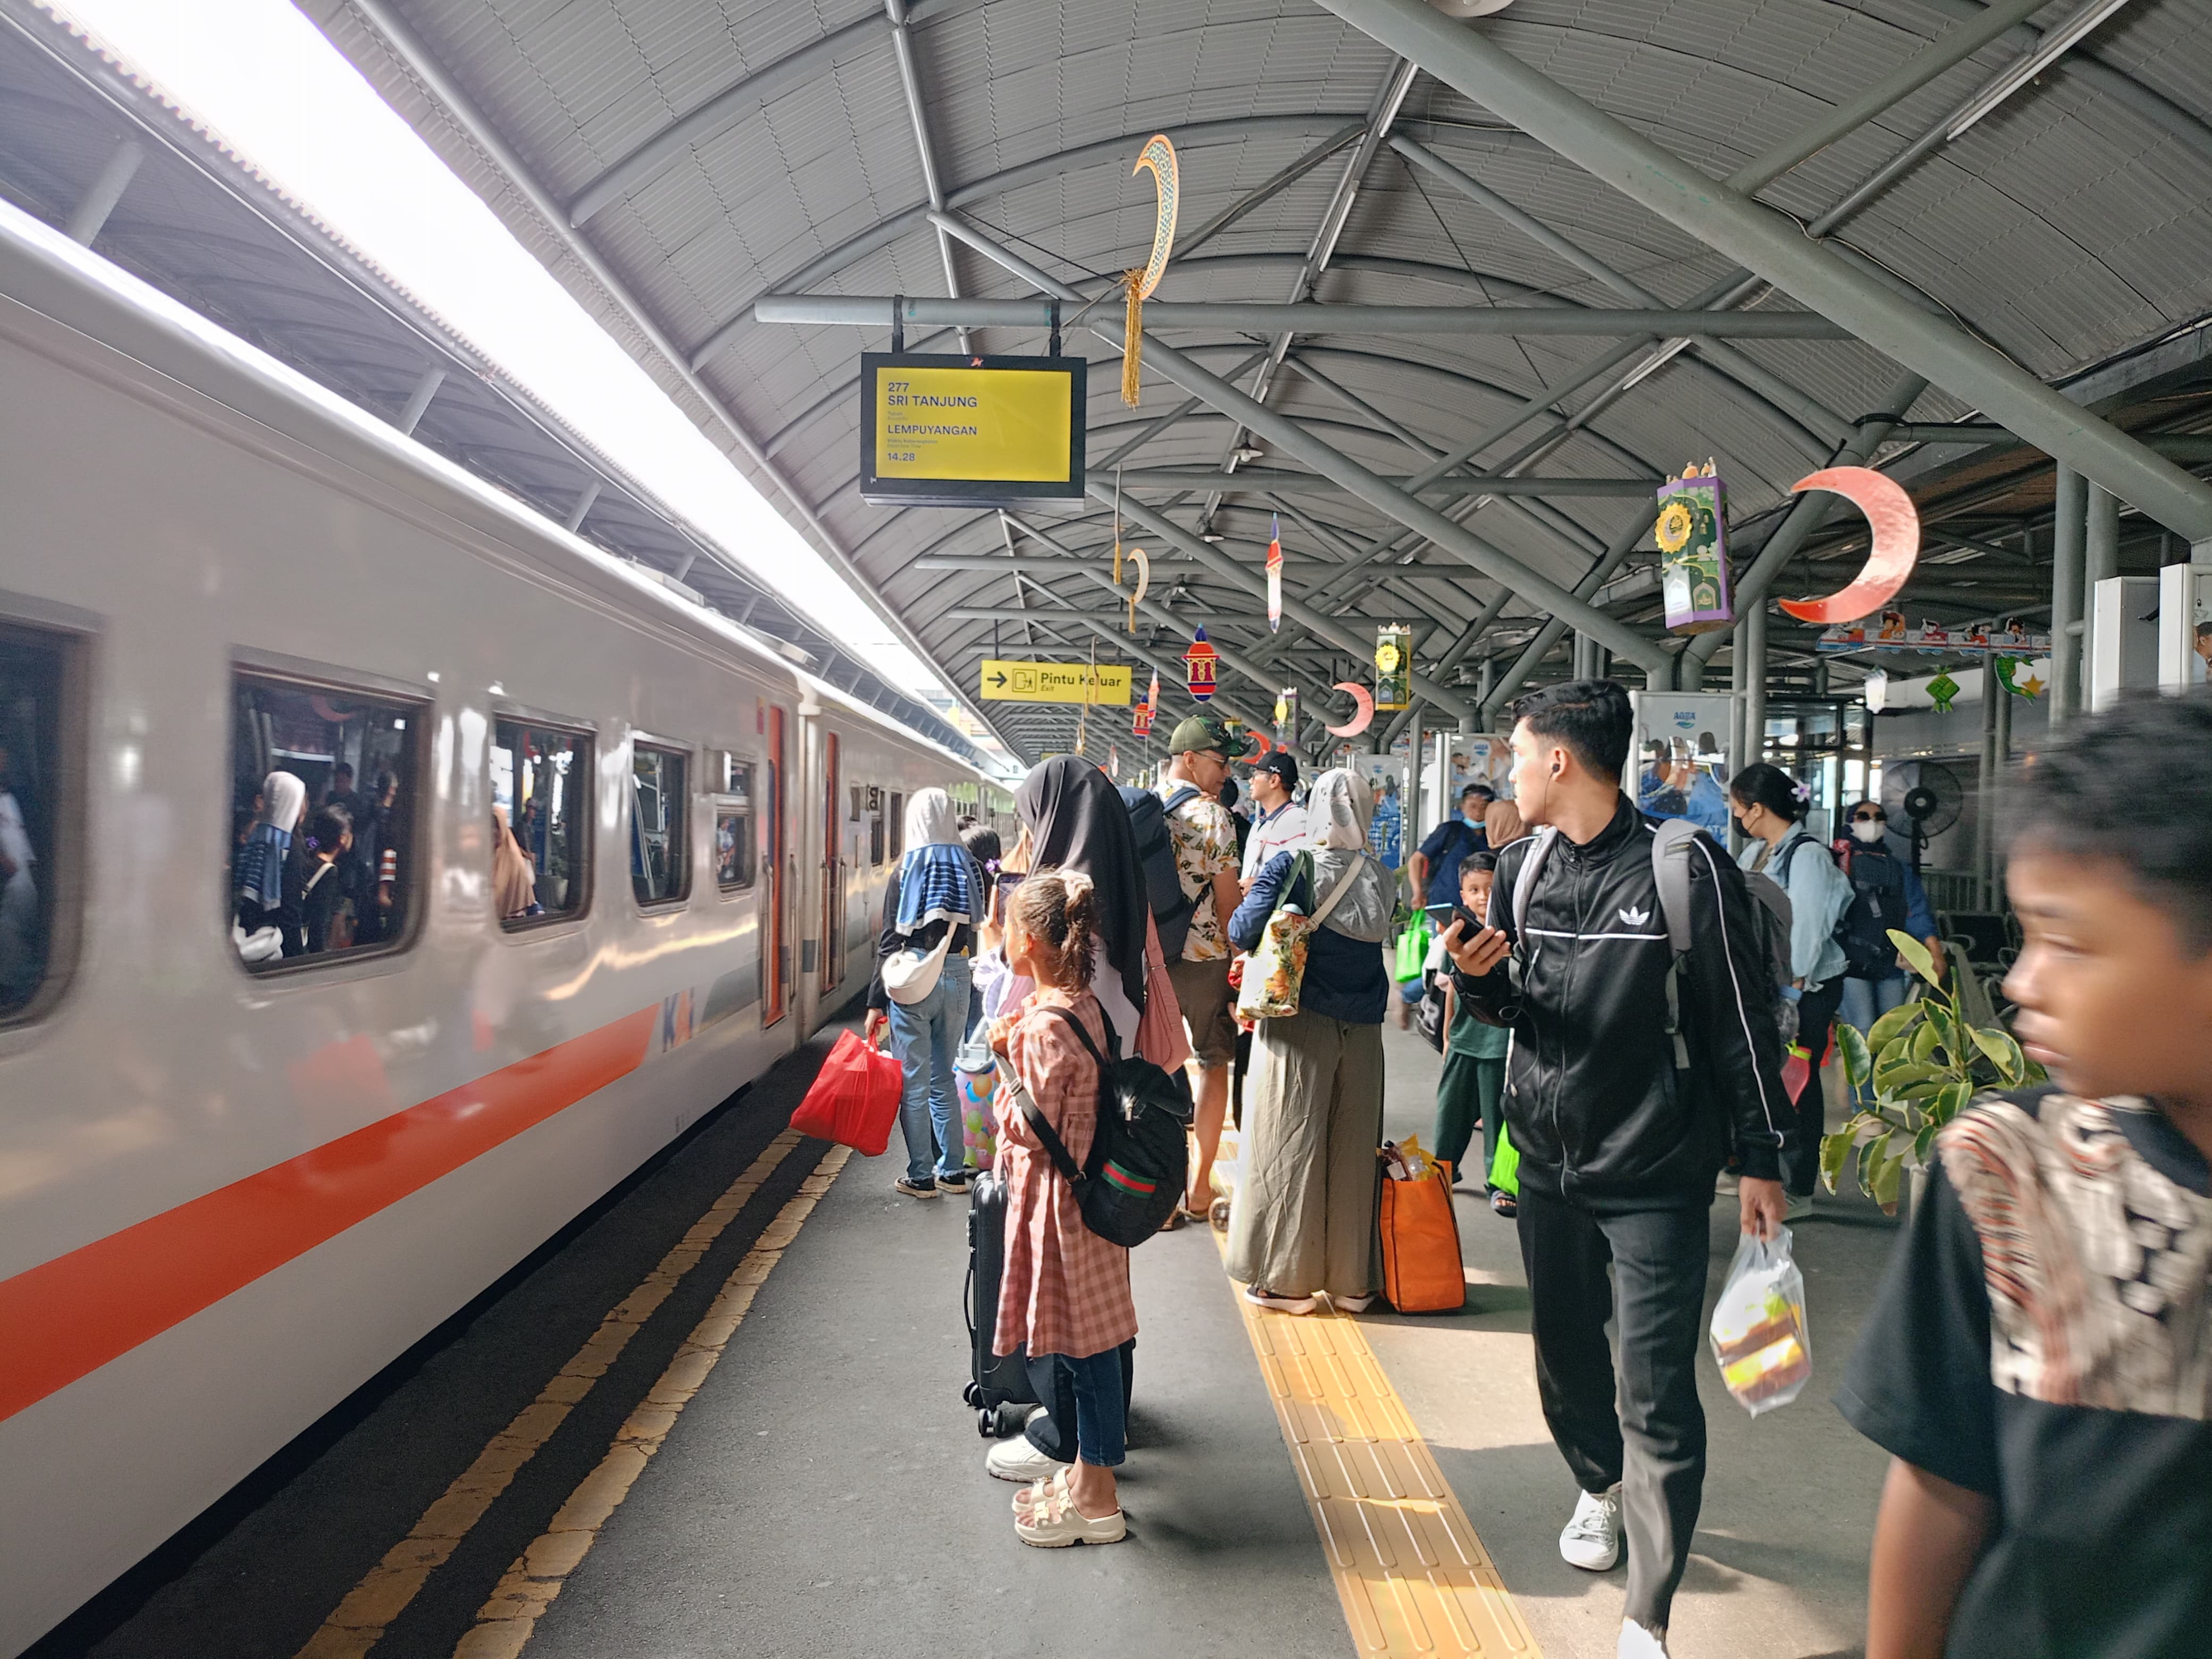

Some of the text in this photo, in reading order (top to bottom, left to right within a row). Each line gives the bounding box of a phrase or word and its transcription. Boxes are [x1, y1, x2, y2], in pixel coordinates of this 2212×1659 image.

[888, 382, 909, 392] 277
[888, 395, 977, 407] SRI TANJUNG
[888, 425, 977, 435] LEMPUYANGAN
[887, 453, 915, 462] 14.28
[1041, 672, 1122, 686] Pintu Keuar
